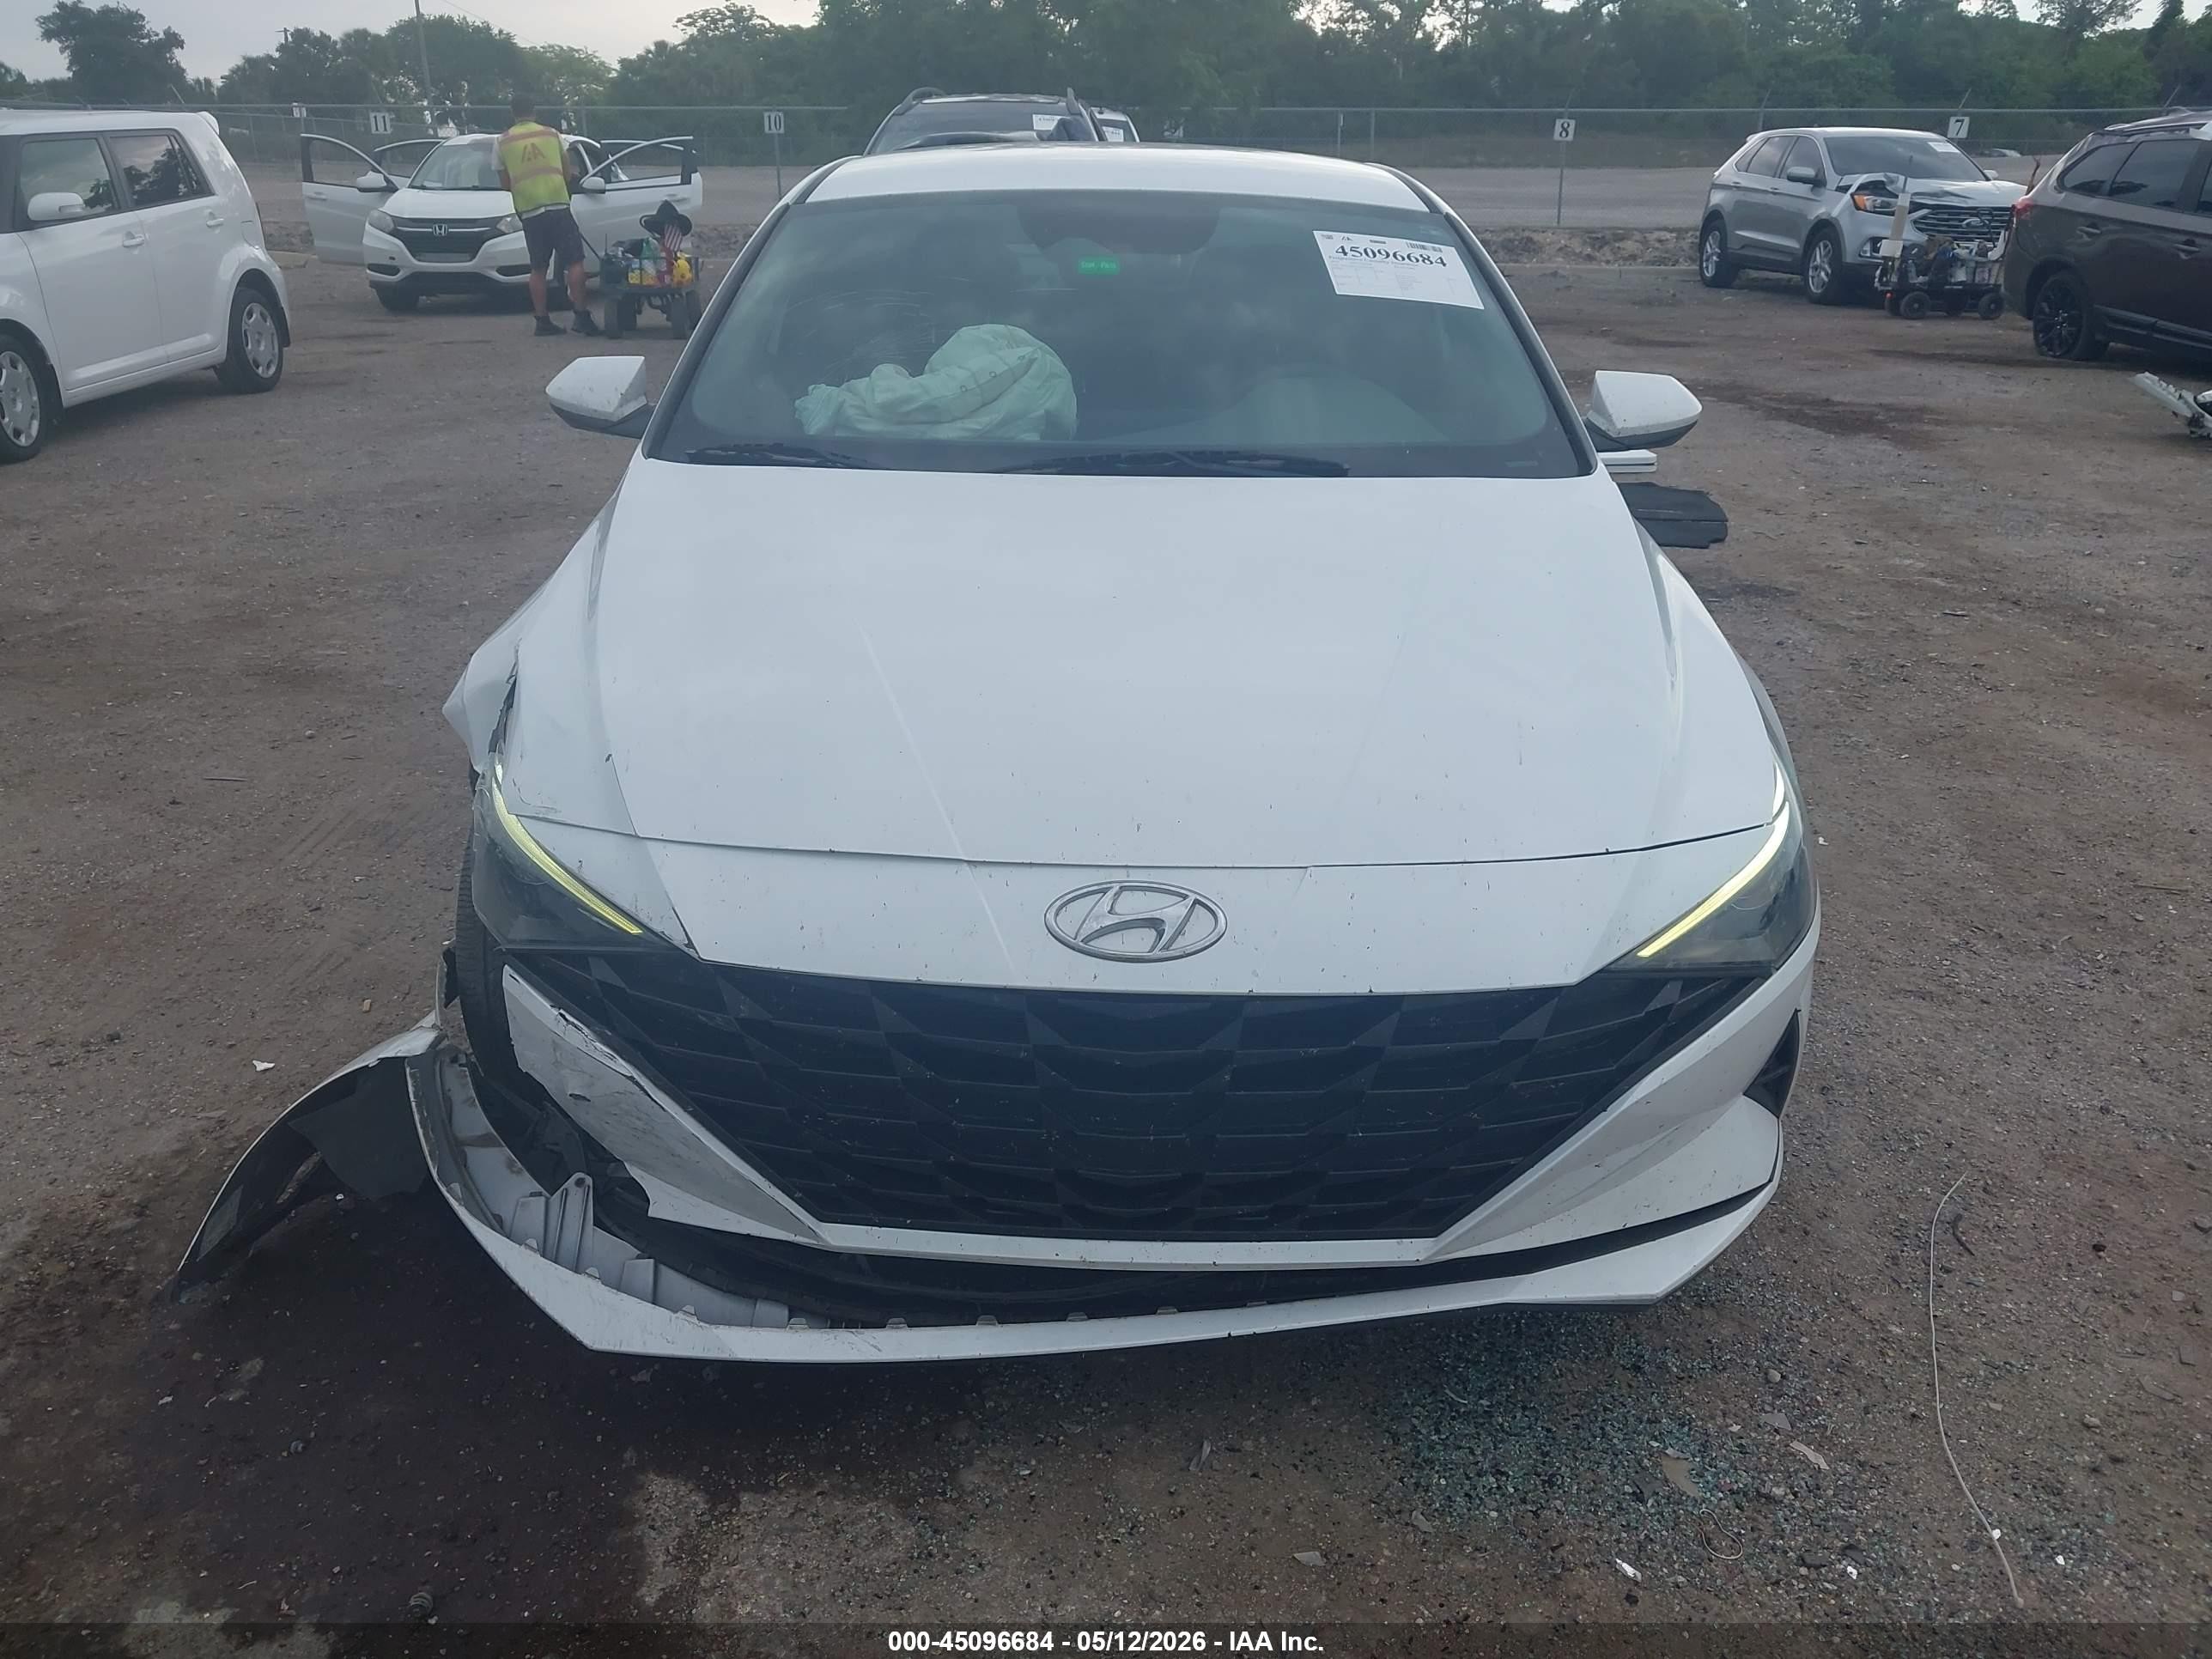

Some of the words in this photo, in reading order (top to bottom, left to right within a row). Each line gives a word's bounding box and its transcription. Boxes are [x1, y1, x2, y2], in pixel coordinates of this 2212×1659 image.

[373, 114, 388, 132] 11
[767, 114, 781, 131] 10
[1559, 121, 1571, 138] 8
[1954, 118, 1966, 136] 7
[1335, 245, 1447, 267] 45096684
